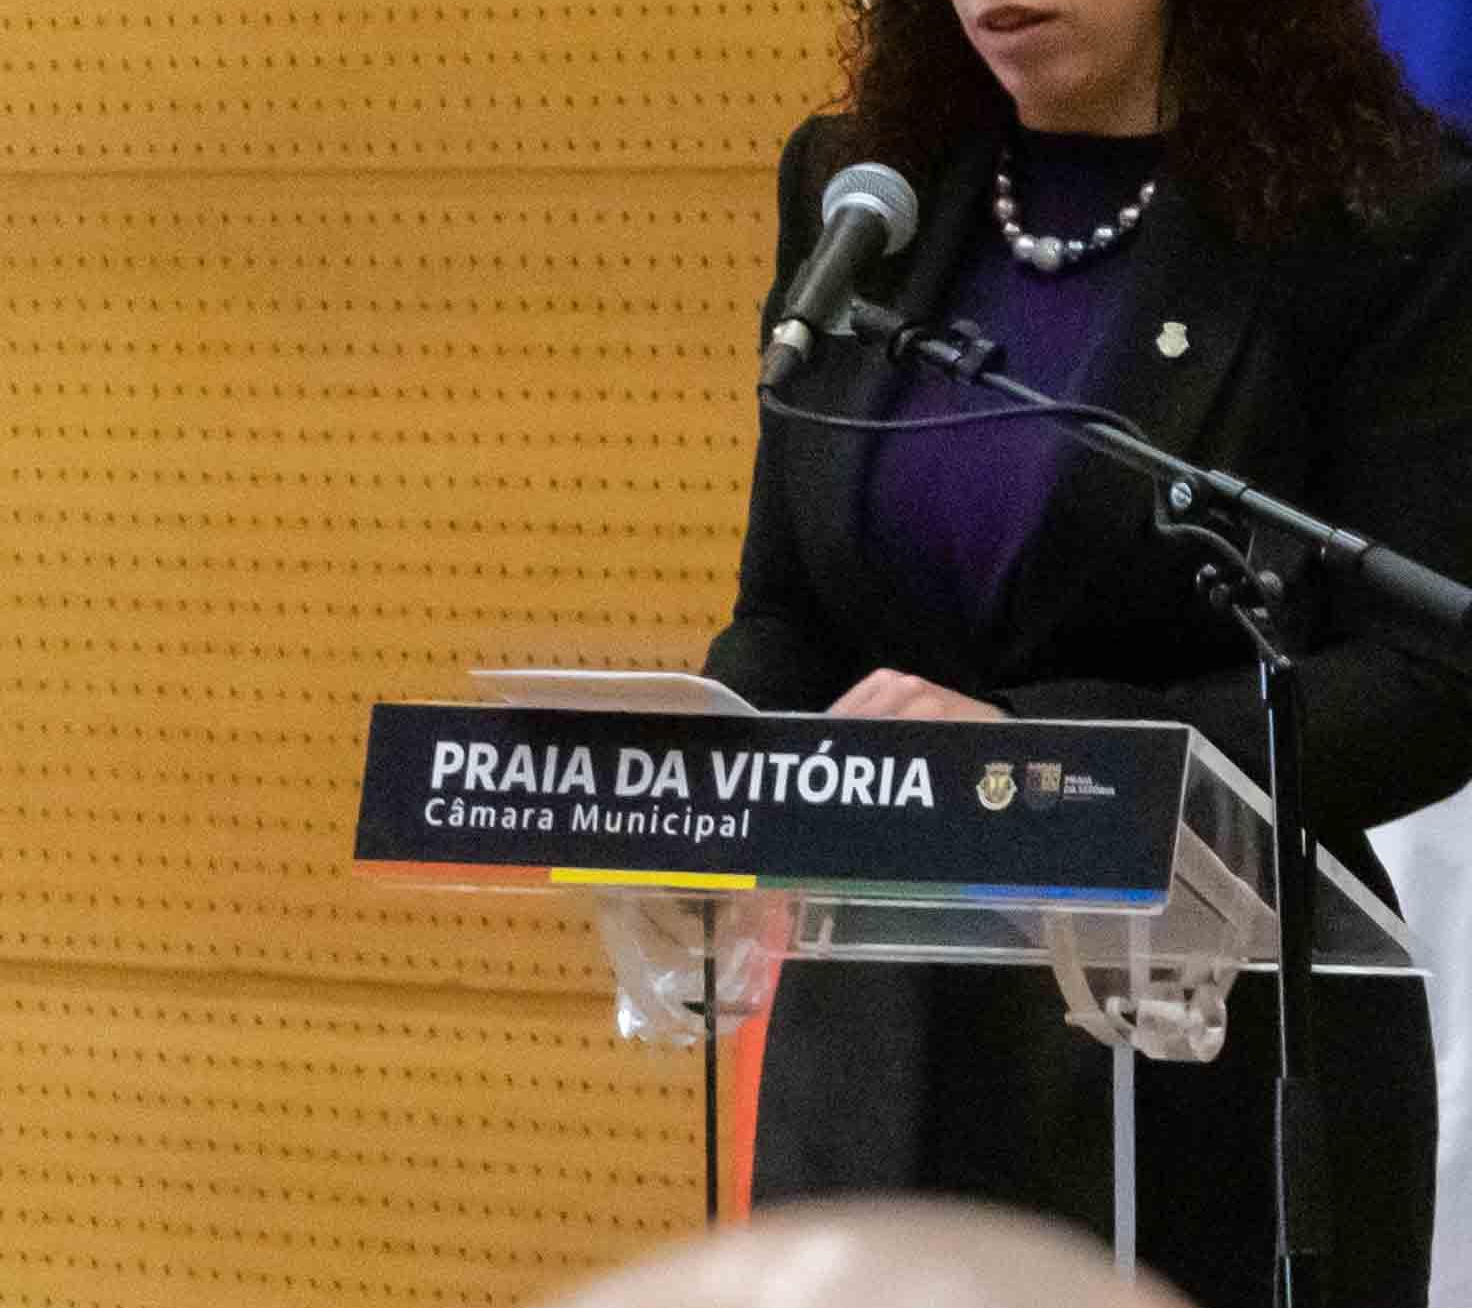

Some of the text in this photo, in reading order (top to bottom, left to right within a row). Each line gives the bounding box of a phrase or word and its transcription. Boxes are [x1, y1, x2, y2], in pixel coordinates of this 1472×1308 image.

[431, 739, 935, 808] PRAIA DA VITÓRIA
[424, 796, 750, 844] Câmara Municipal
